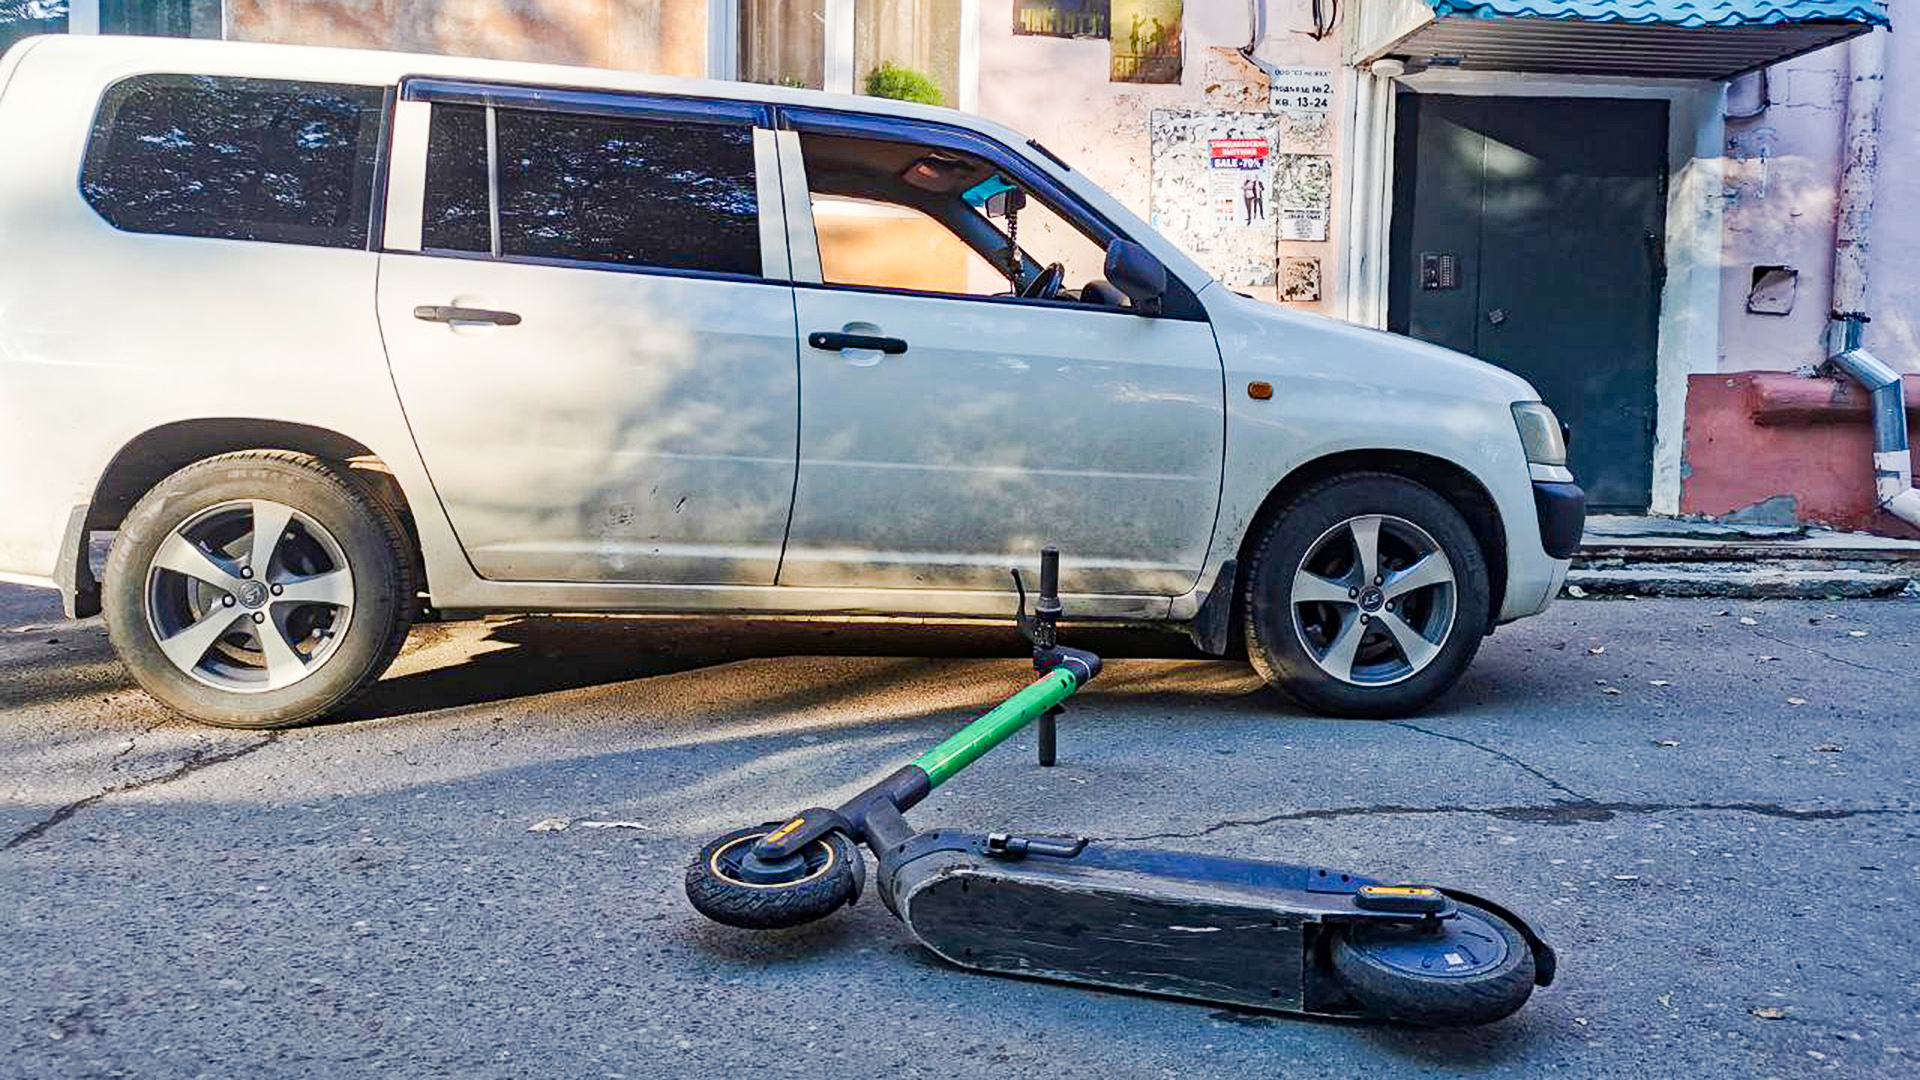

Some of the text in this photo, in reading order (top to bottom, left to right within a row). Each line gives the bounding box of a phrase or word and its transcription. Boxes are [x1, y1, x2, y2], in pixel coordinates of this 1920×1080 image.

[1297, 97, 1328, 107] 13-24
[1214, 159, 1260, 168] SALE -70%
